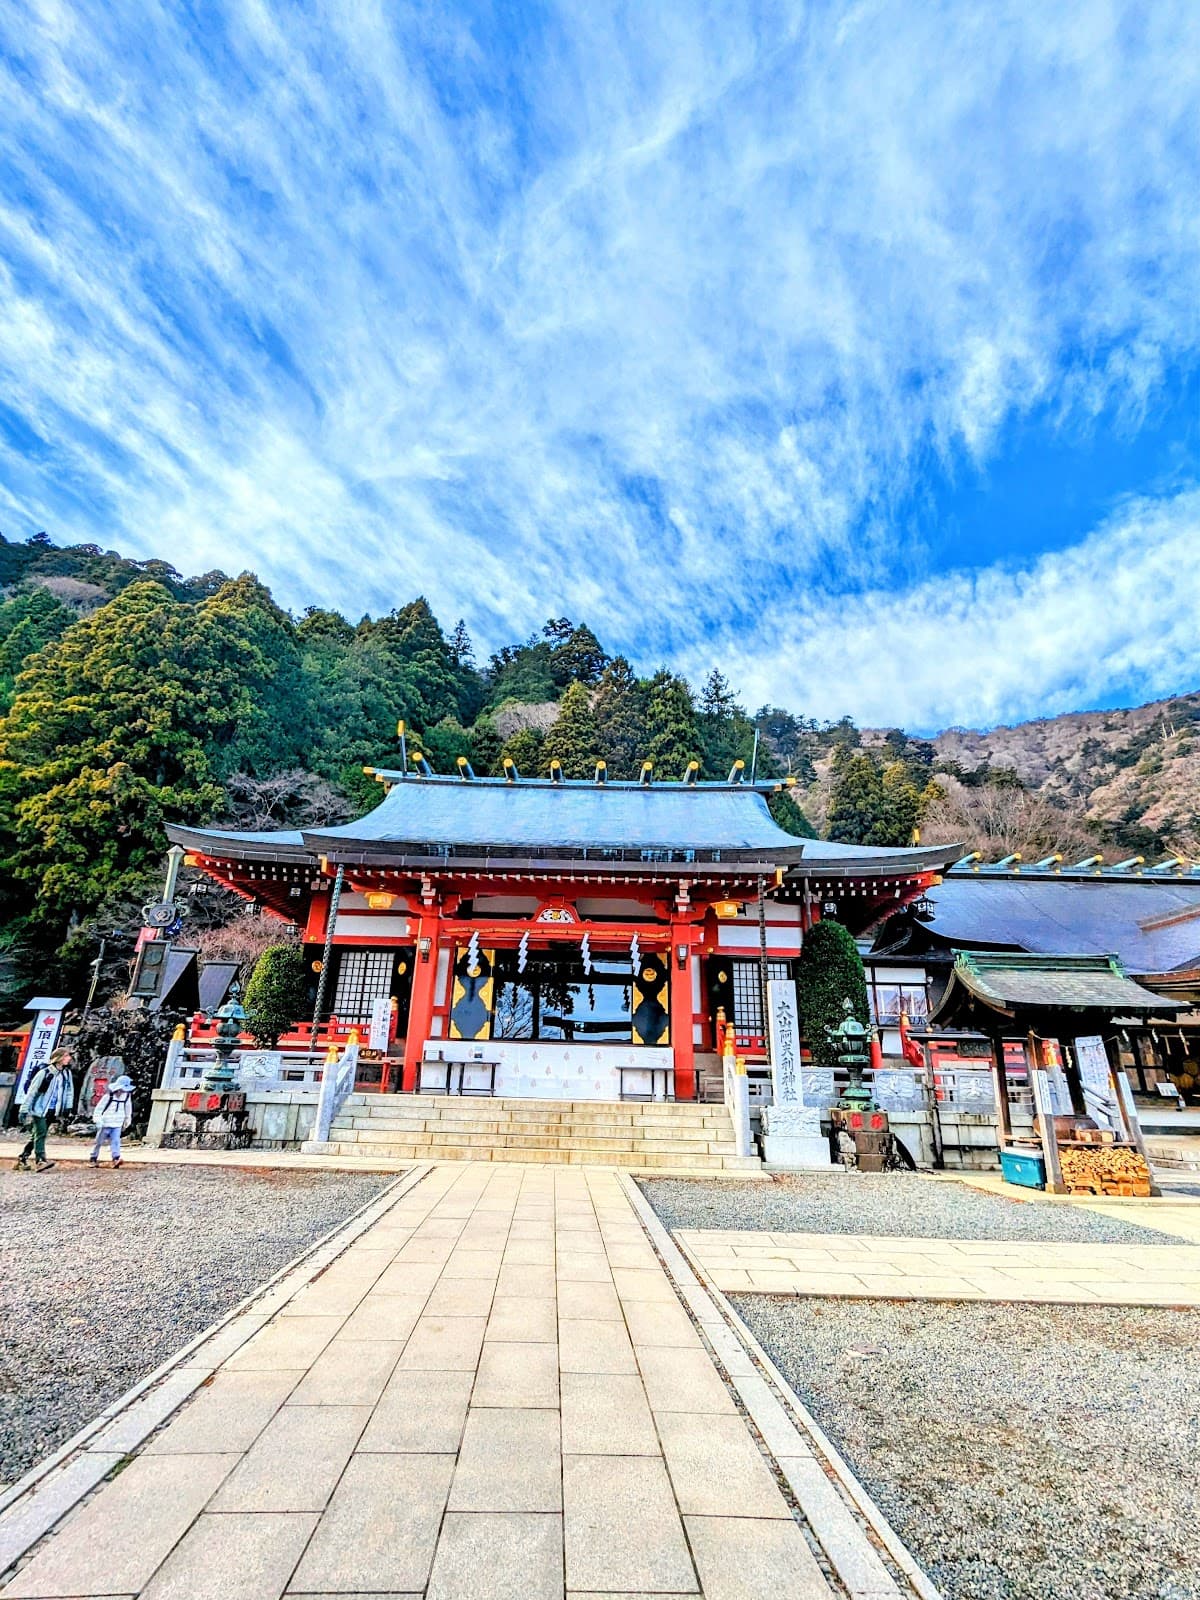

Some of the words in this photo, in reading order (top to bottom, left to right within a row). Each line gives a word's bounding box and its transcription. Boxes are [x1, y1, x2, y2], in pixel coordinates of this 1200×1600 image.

[776, 1000, 798, 1102] 大山阿夫利神社
